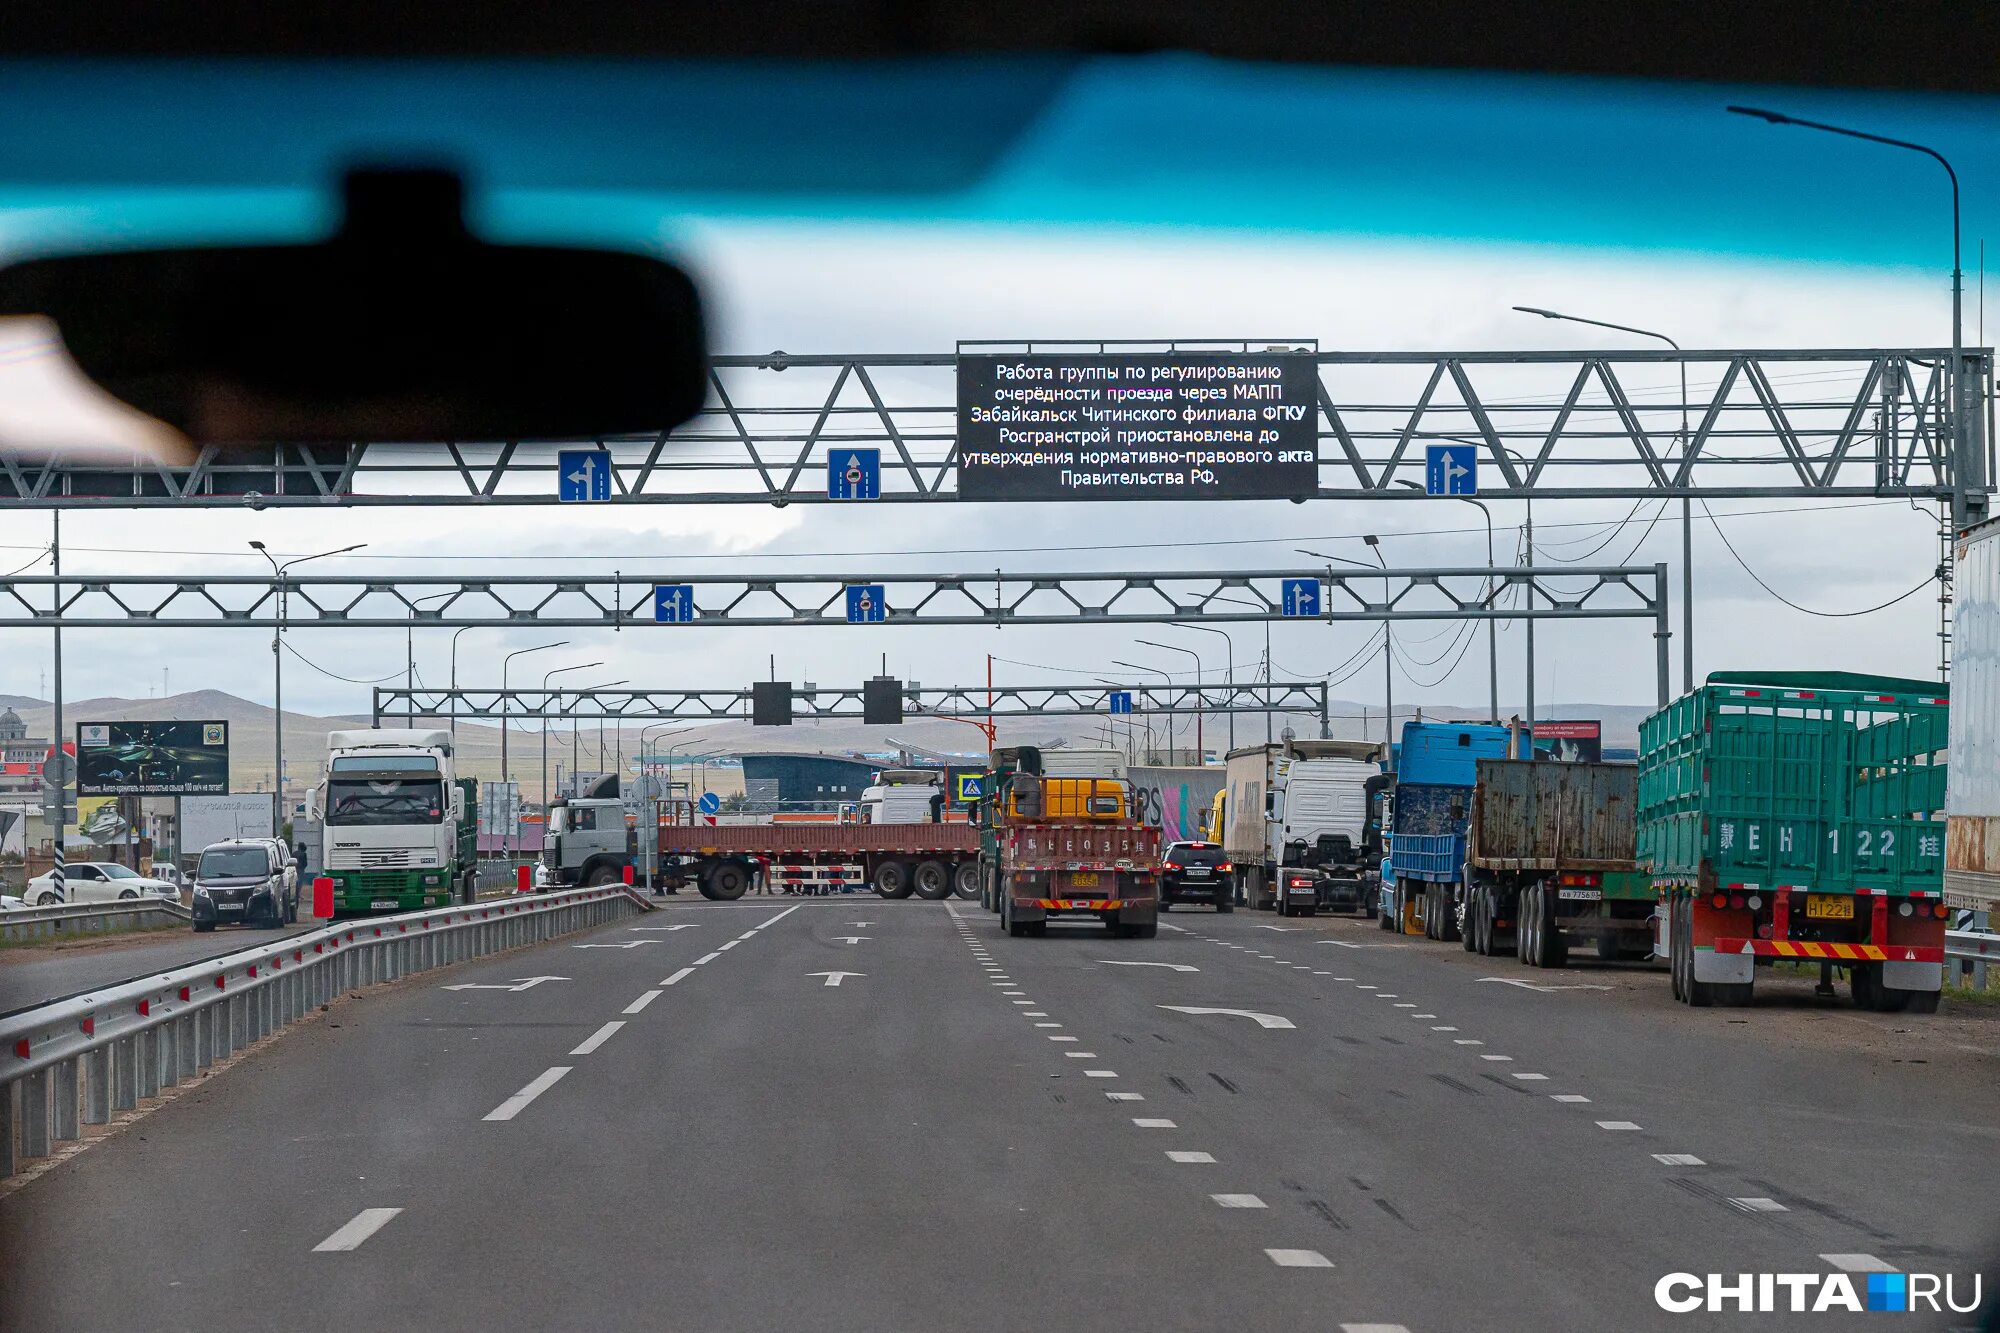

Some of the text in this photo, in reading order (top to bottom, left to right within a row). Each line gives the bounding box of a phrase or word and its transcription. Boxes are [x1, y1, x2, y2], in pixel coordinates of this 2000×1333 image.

[997, 363, 1281, 383] Работа группы по регулированию
[995, 385, 1281, 404] очерёдности проезда через МАПП
[971, 405, 1306, 424] Забайкальск Читинского филиала ФГКУ
[1000, 427, 1279, 446] Росгранстрой приостановлена до
[963, 451, 1313, 468] утверждения нормативно-правового акта
[1062, 469, 1218, 487] Правительства РФ.
